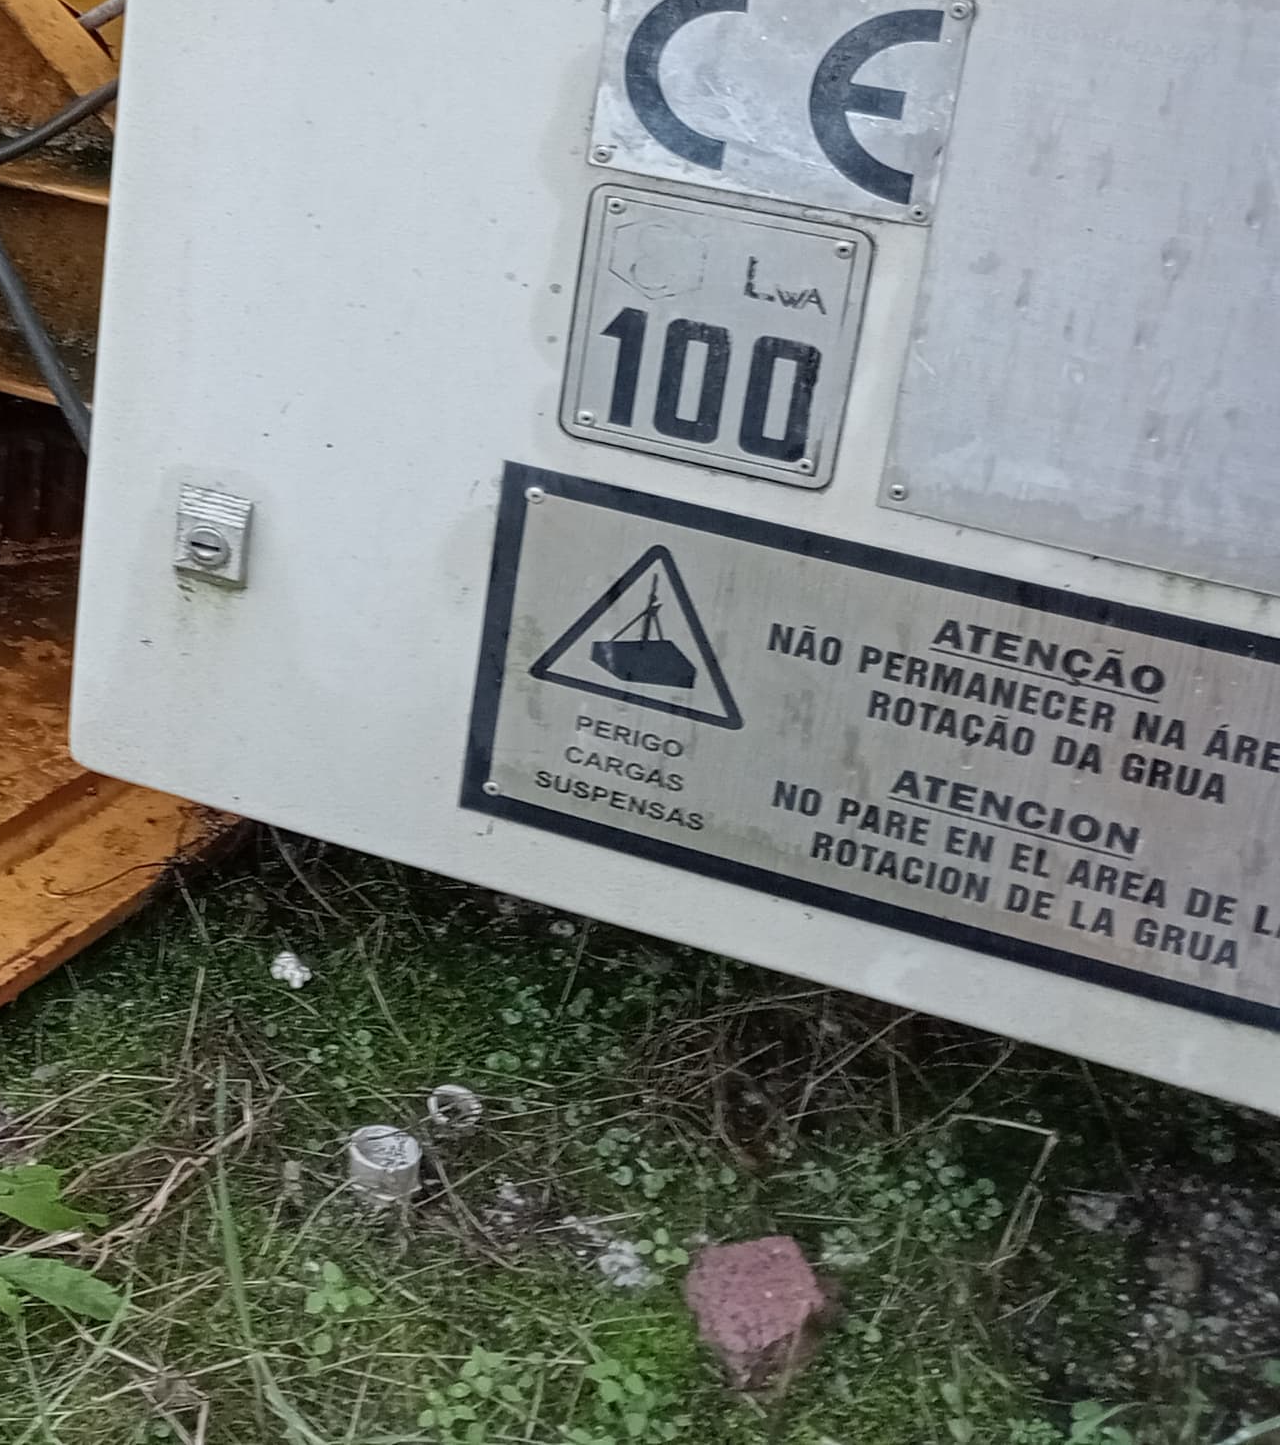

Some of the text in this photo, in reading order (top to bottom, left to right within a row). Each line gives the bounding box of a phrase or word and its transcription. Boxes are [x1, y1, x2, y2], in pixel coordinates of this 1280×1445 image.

[600, 306, 823, 463] 100
[767, 621, 842, 668] NÃO
[858, 645, 1117, 733] PERMANECER
[1132, 711, 1188, 751] NA
[932, 618, 1166, 696] ATENÇÃO
[564, 745, 685, 792] CARGAS
[576, 714, 685, 758] PERIGO
[866, 690, 1226, 804] ROTAÇÃO DA GRUA
[534, 770, 705, 831] SUSPENSAS
[889, 769, 1141, 855] ATENCION
[771, 779, 1280, 938] NO PARE EN EL AREA DE L
[809, 831, 1239, 971] ROTACION DE LA GRUA
